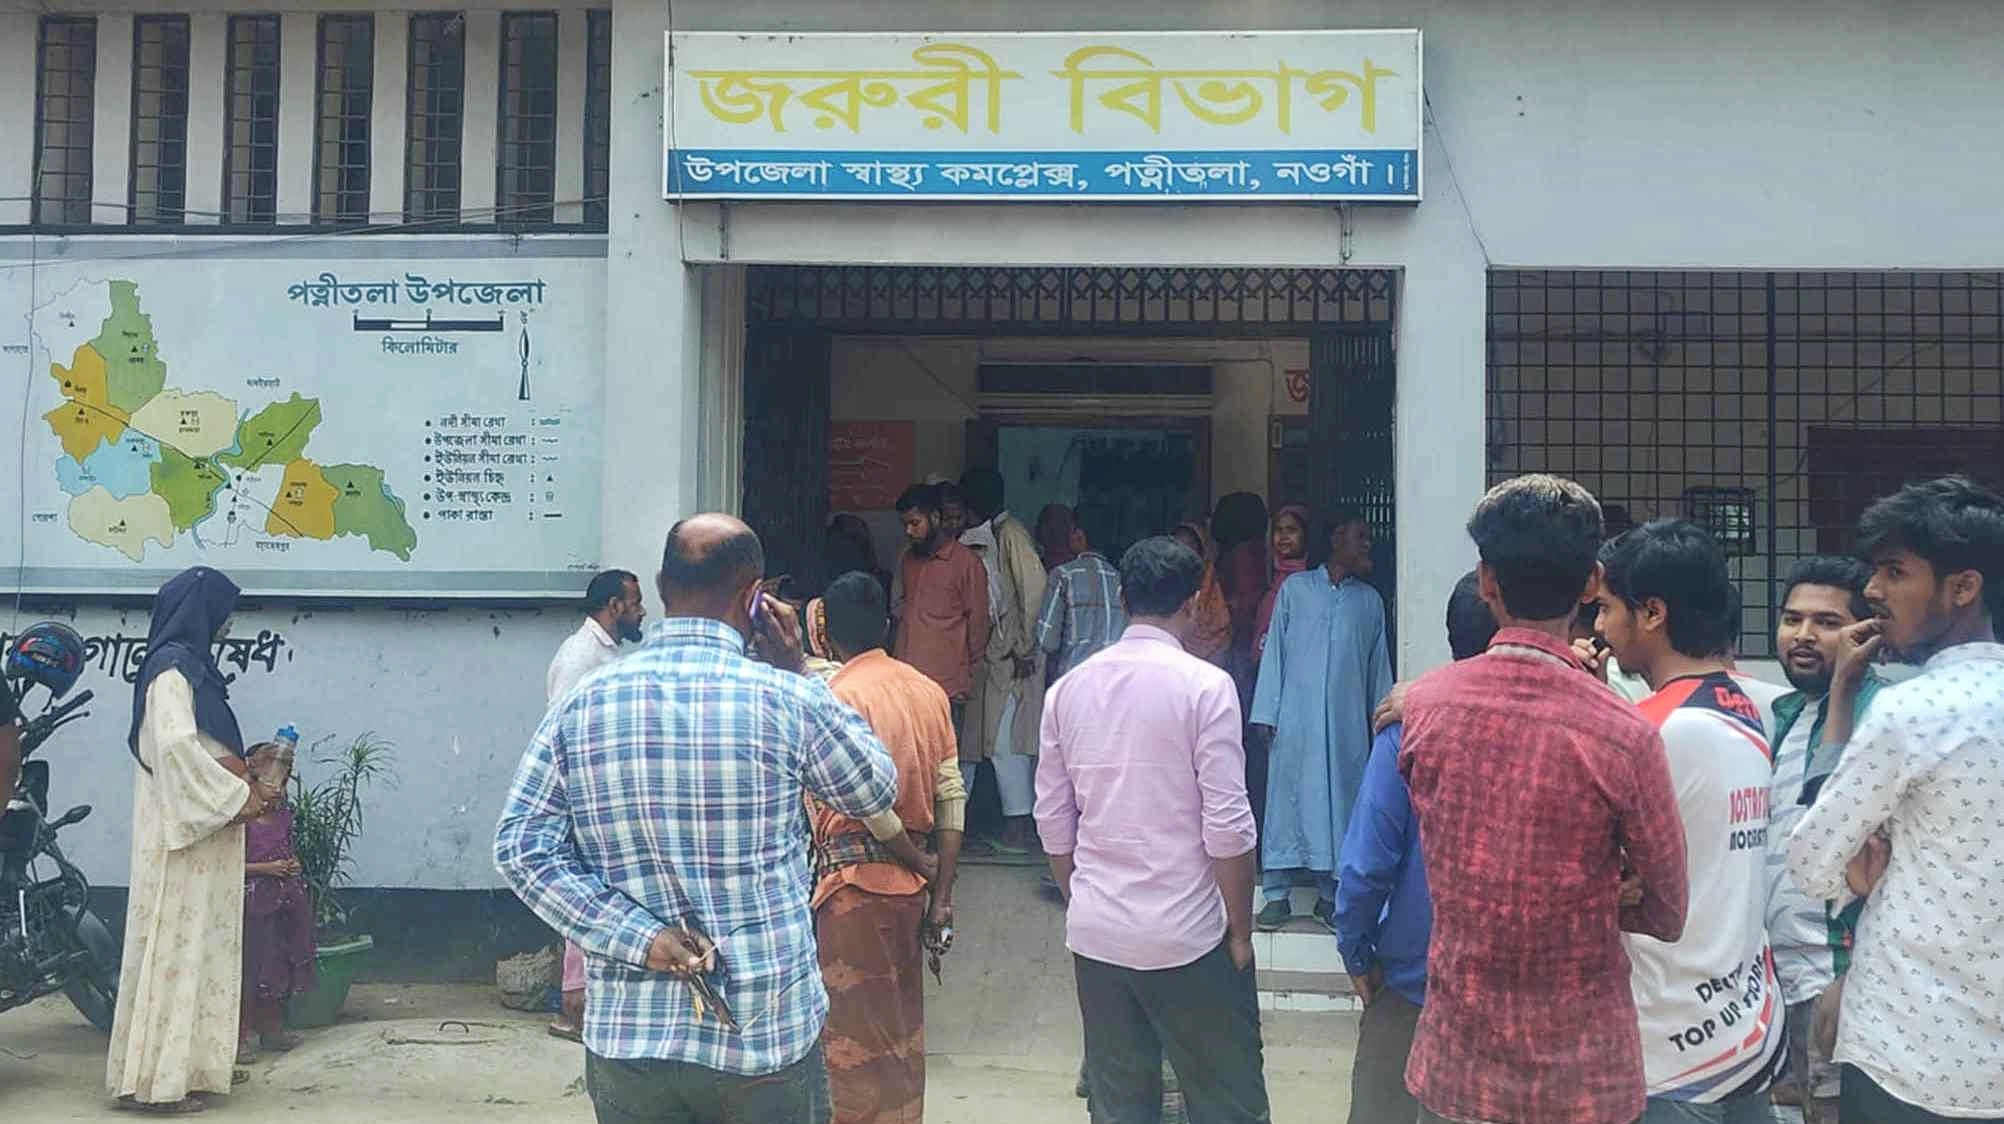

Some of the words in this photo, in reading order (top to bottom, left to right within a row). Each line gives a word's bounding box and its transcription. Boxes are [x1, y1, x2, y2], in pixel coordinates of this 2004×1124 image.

[683, 43, 1024, 134] জরুরী
[1048, 45, 1400, 134] বিভাগ
[684, 153, 833, 188] উপজেলা
[841, 160, 928, 190] স্বাস্থ্য
[936, 161, 1088, 191] কমপ্লেক্স,
[1104, 155, 1261, 189] পত্নীতলা,
[1272, 155, 1374, 186] নওগাঁ
[287, 273, 399, 306] পত্নীতলা
[405, 273, 546, 304] উপজেলা
[382, 337, 459, 354] কিলোমিটার
[483, 417, 506, 429] রেখা
[434, 431, 477, 447] উপজেলা
[480, 431, 501, 446] সীমা
[503, 435, 527, 446] রেখা
[435, 449, 476, 466] ইউনিয়ন
[479, 449, 500, 464] সীমা
[502, 453, 528, 464] রেখা
[436, 468, 480, 486] ইউনিয়ন
[438, 510, 462, 520] পাকা
[1668, 1019, 1716, 1052] TOP
[1720, 1001, 1742, 1027] UP
